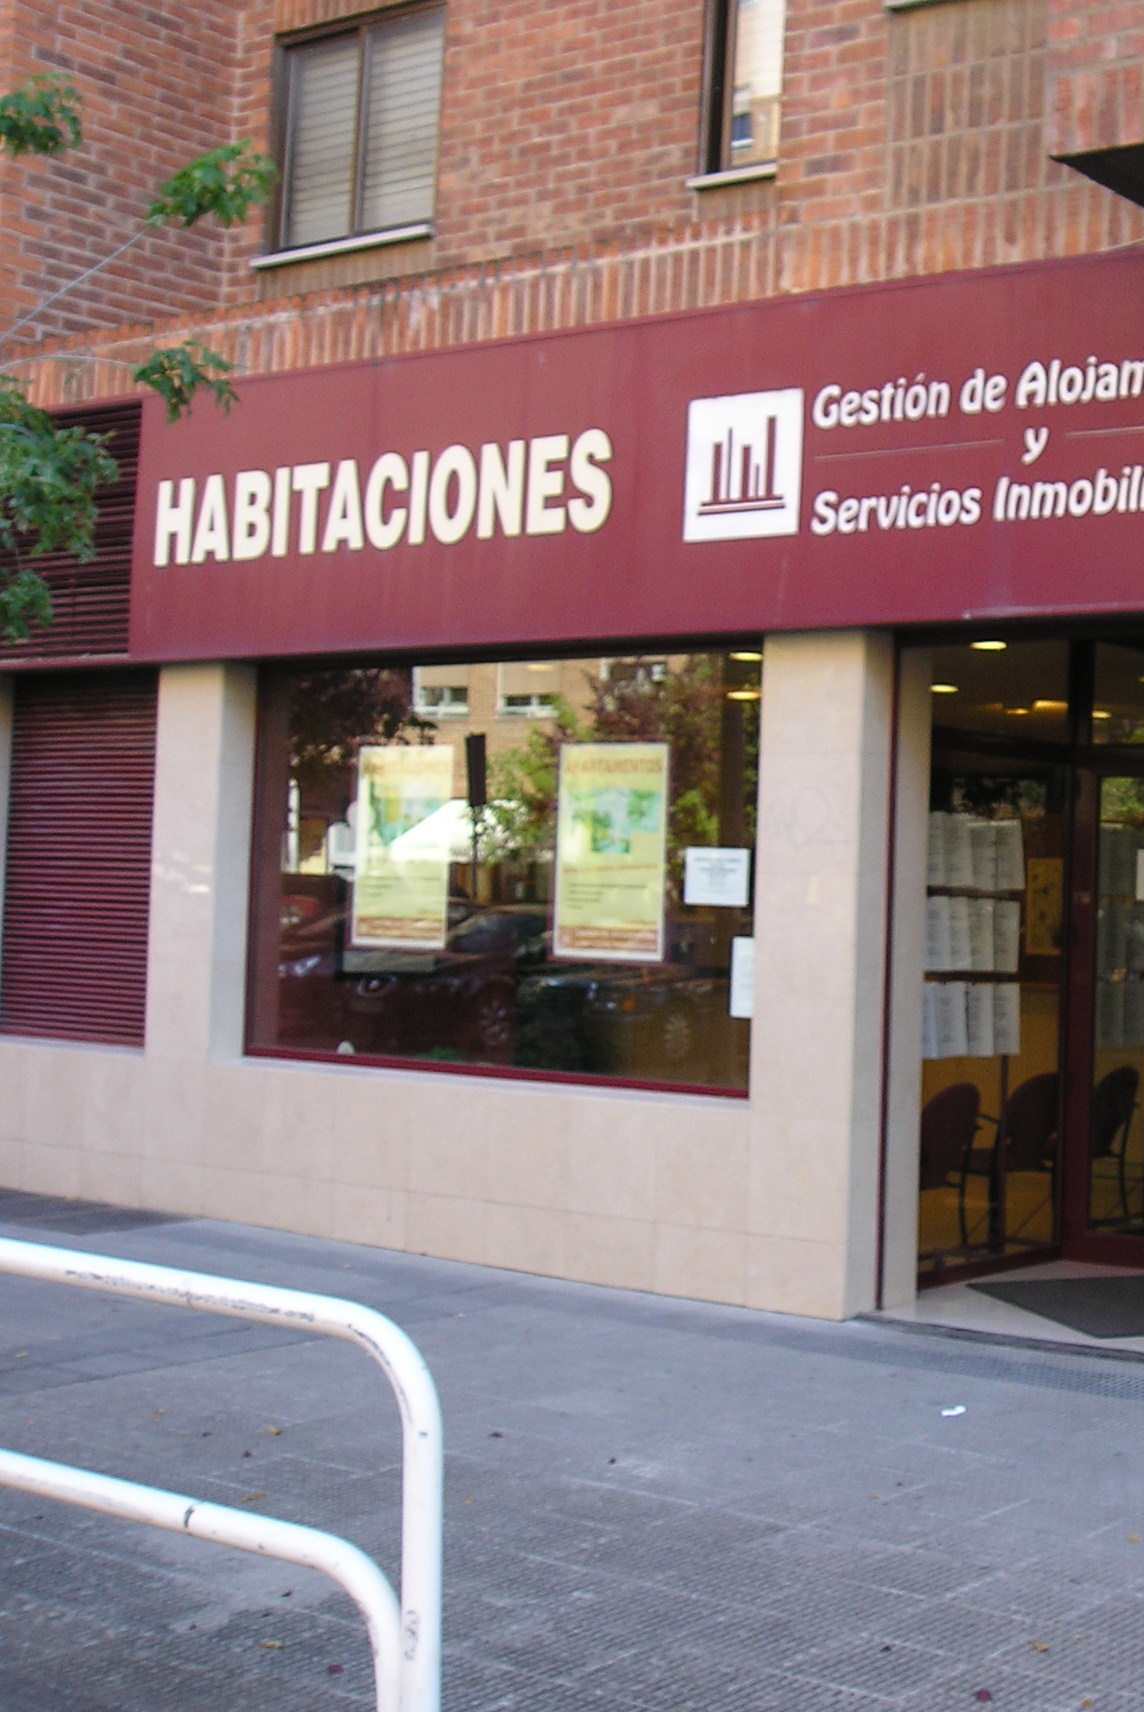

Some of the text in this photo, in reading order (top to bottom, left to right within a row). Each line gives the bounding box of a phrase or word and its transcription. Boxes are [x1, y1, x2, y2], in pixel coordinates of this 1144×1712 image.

[812, 371, 950, 430] Gestión
[960, 367, 1006, 415] de
[1021, 426, 1049, 465] y
[153, 427, 613, 567] HABITACIONES
[810, 482, 982, 537] Servicios
